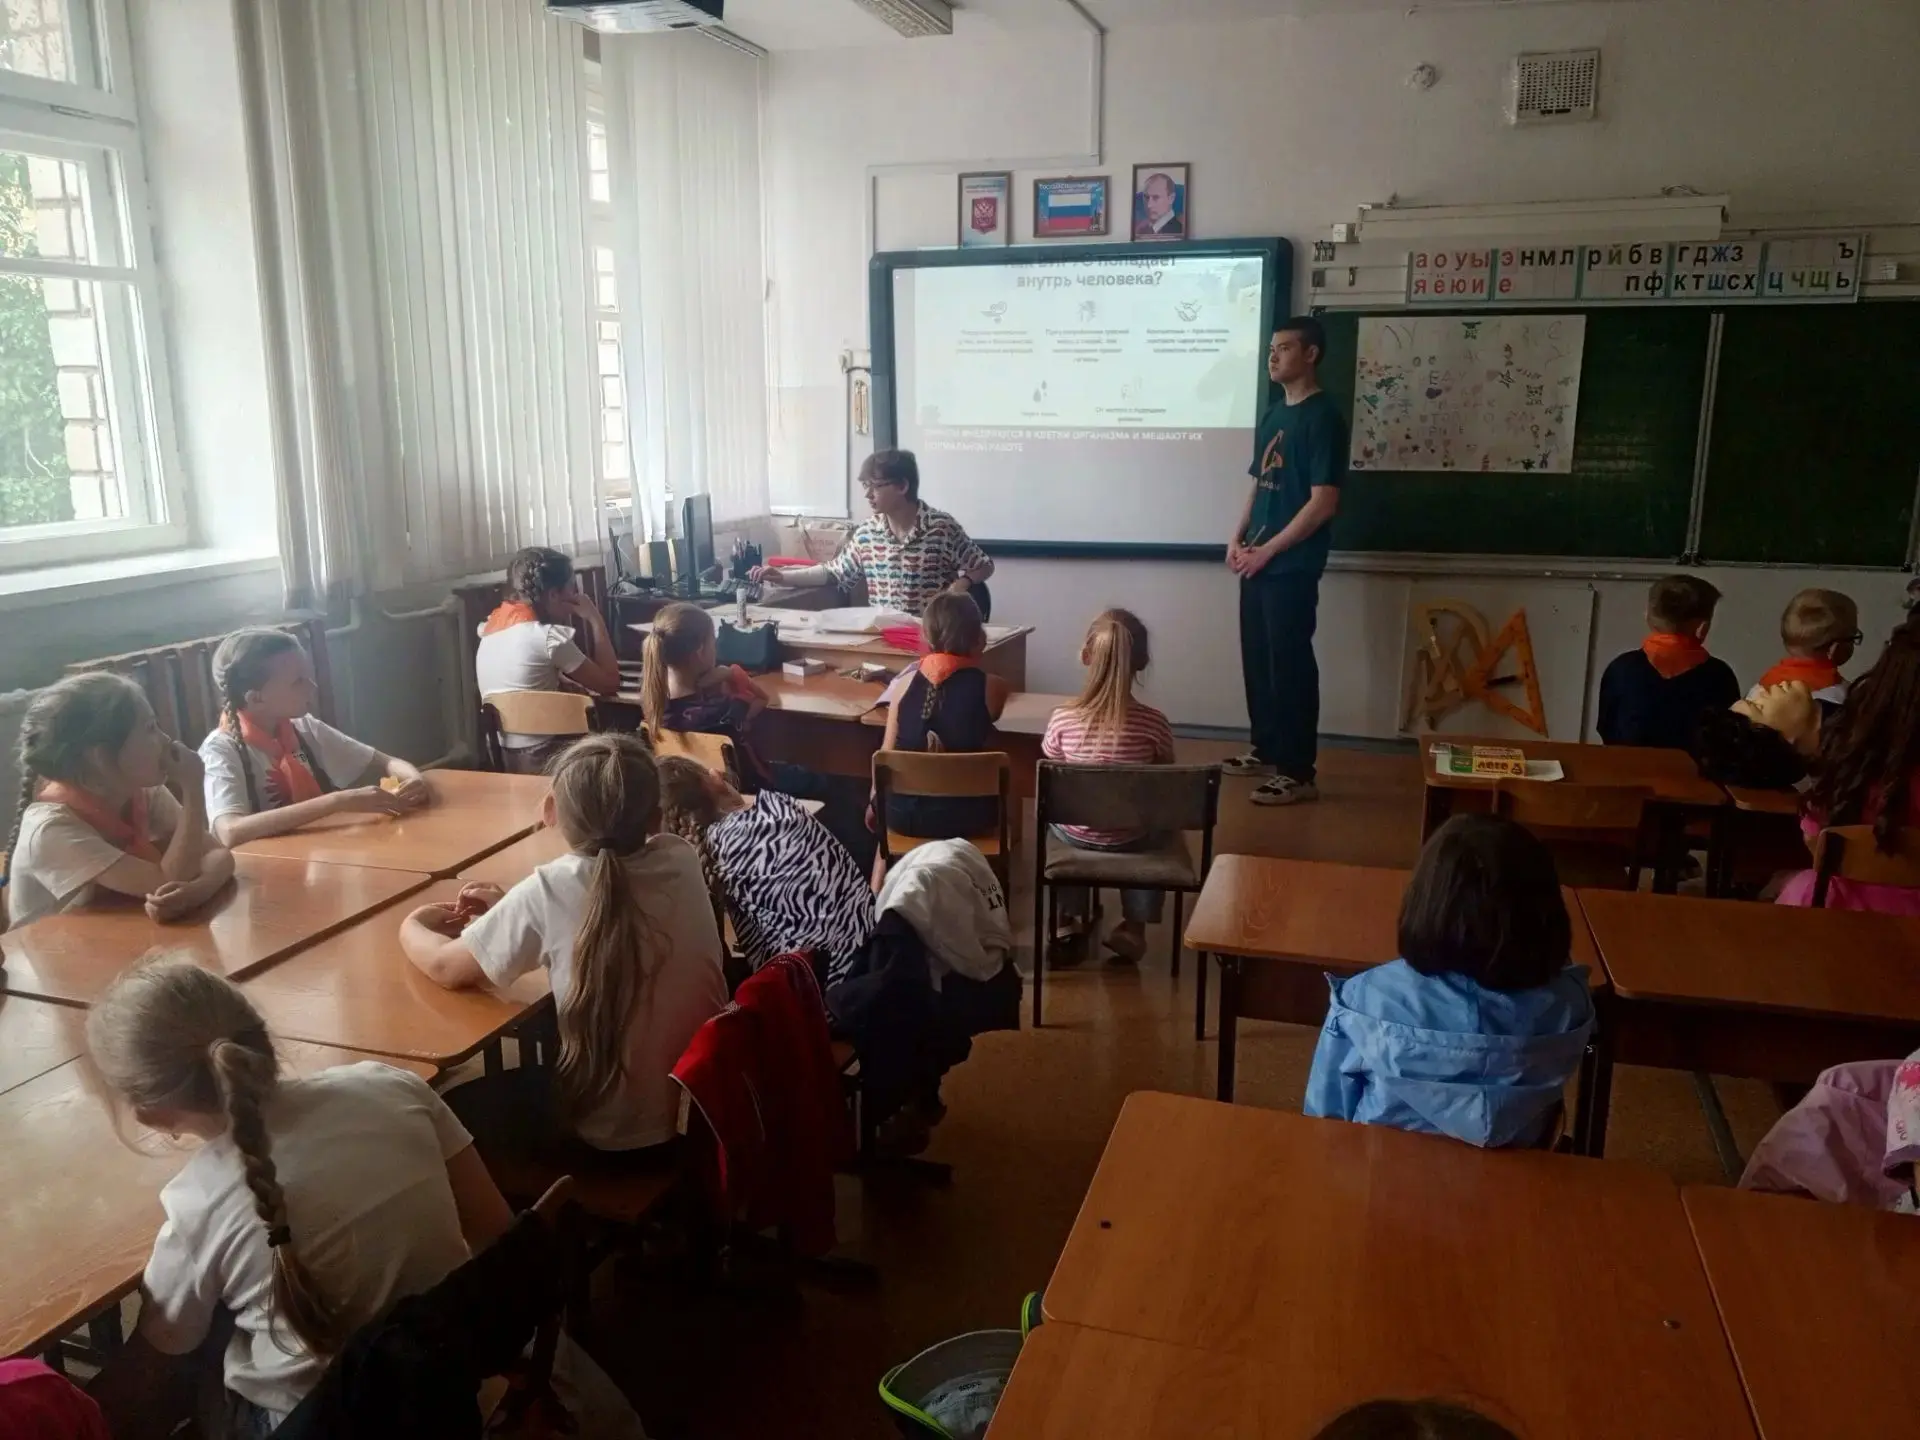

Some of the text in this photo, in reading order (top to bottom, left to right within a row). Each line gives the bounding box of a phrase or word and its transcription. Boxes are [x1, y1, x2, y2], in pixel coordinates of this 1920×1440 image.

[1017, 271, 1163, 291] внутрь человека?
[1073, 431, 1130, 440] ОРГАНИЗМА
[1132, 431, 1140, 440] И
[1141, 431, 1187, 440] МЕШАЮТ
